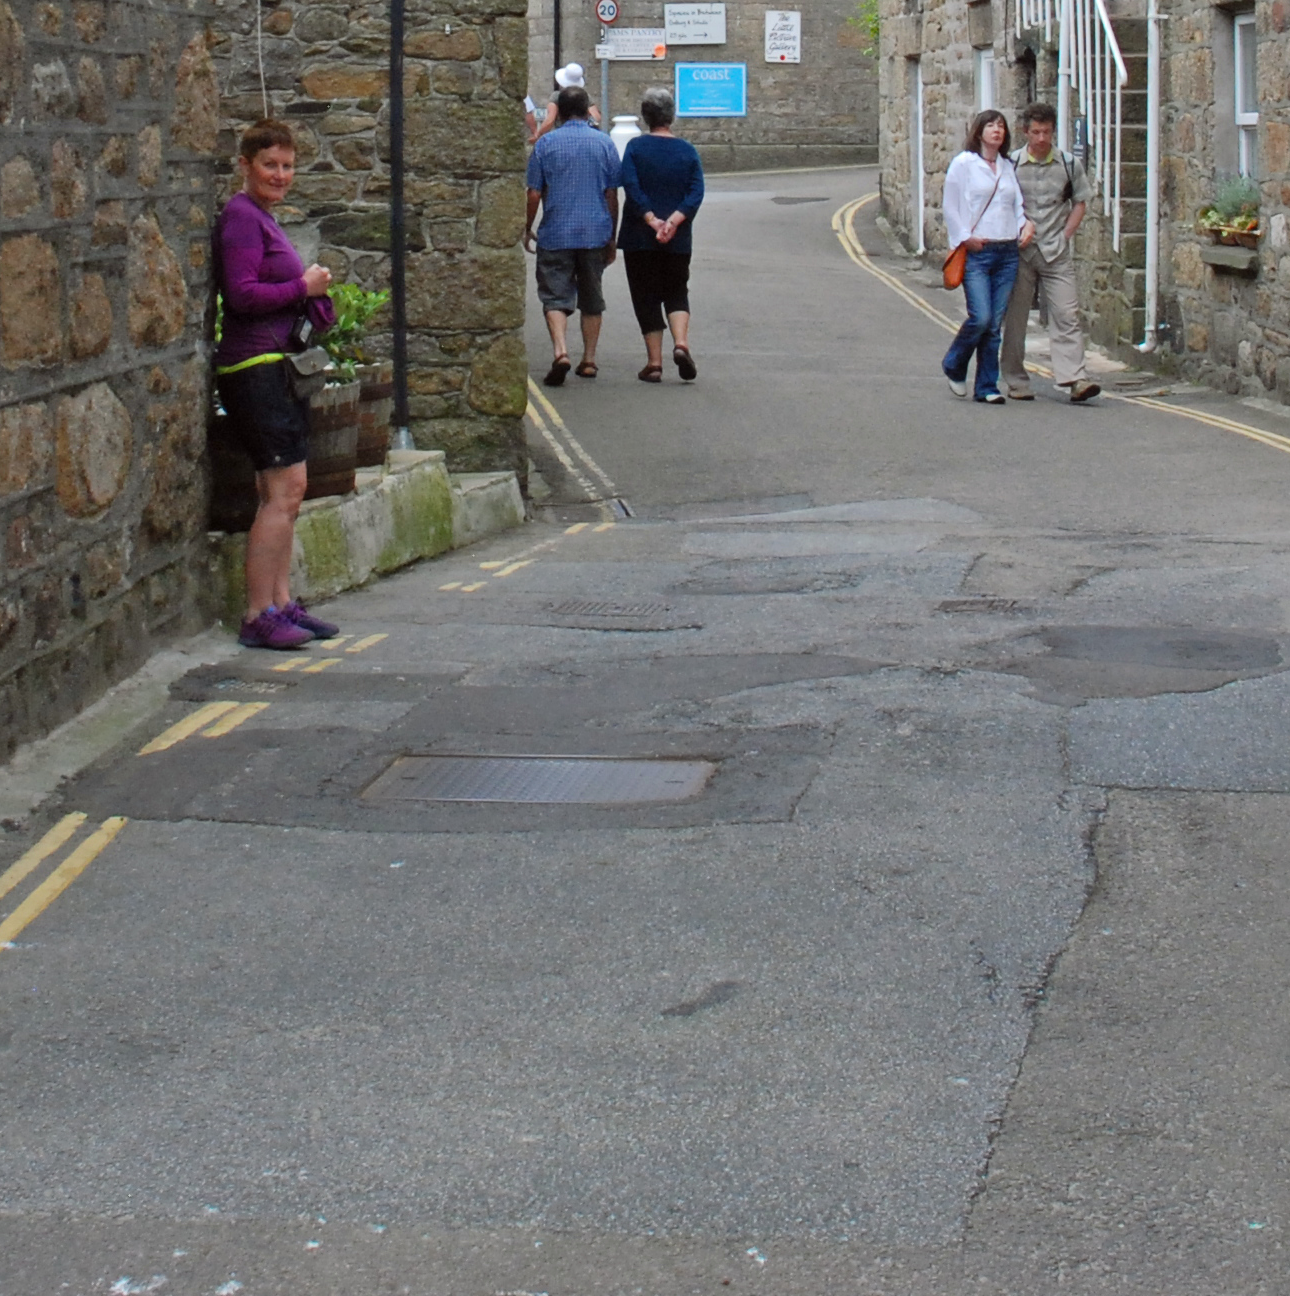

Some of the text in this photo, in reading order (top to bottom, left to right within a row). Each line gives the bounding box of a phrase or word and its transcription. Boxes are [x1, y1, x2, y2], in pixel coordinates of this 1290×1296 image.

[599, 5, 615, 15] 20
[777, 12, 791, 21] The
[766, 42, 797, 55] Gallery
[692, 68, 731, 80] coast
